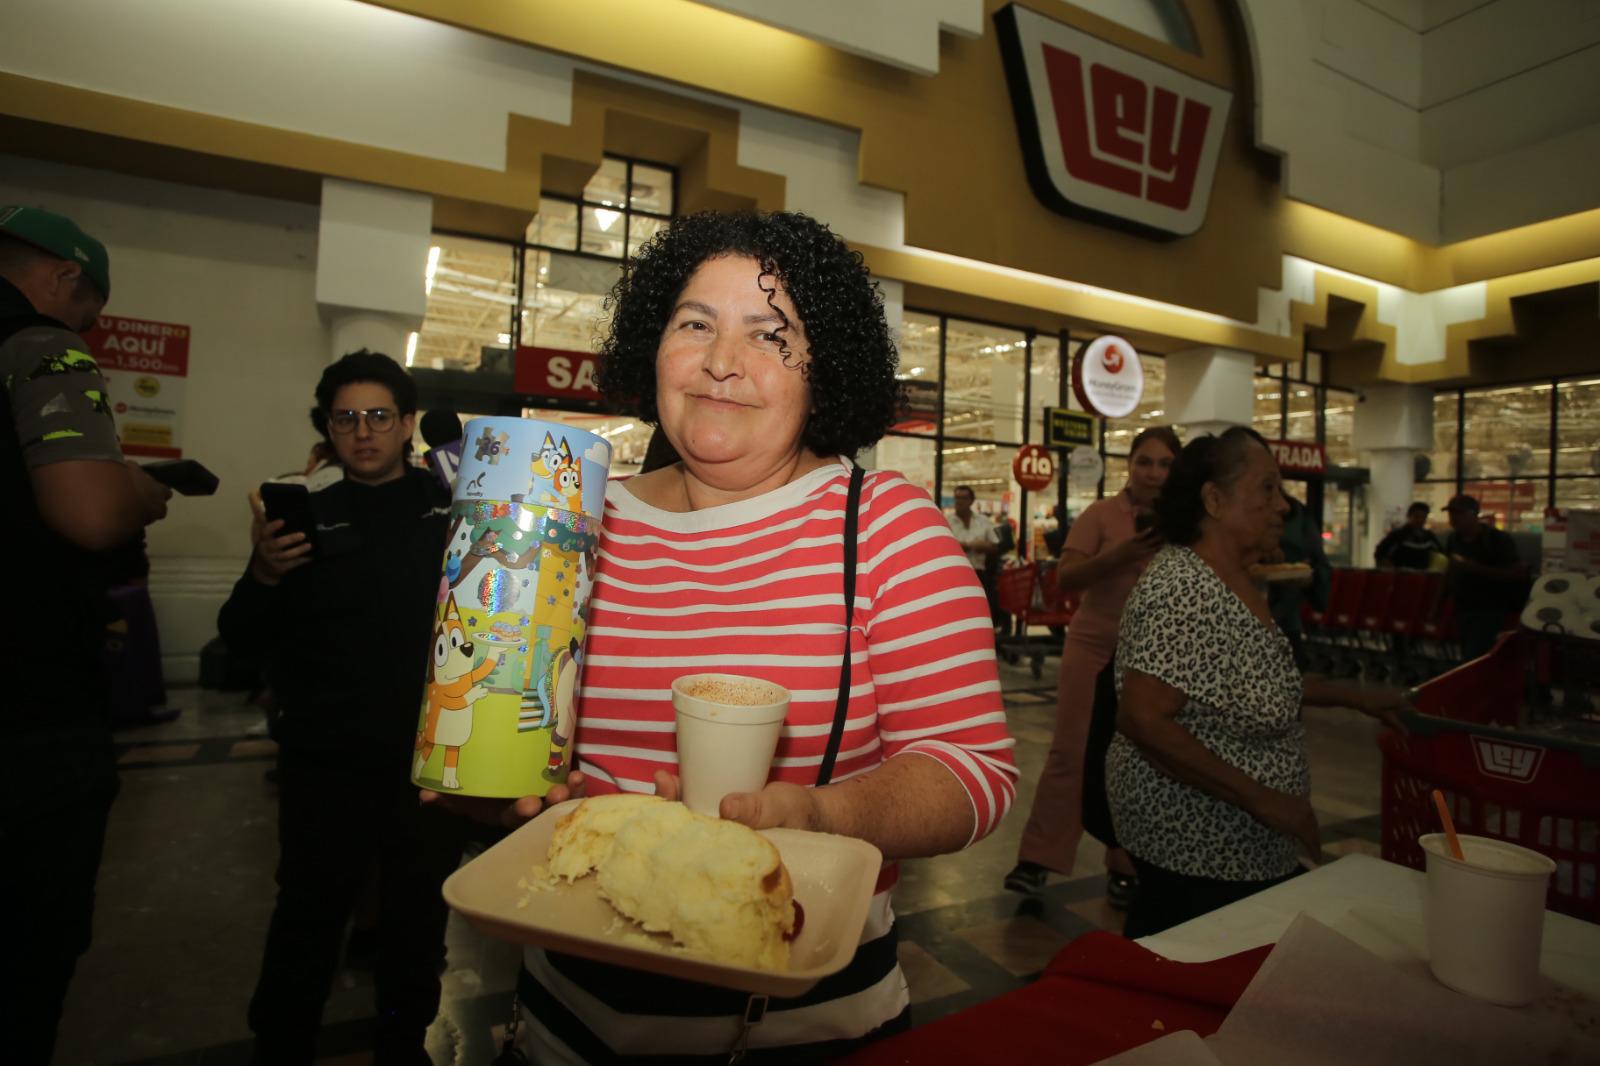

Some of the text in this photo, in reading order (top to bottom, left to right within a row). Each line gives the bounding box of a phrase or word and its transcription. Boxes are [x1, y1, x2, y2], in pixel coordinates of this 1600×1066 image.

[98, 317, 113, 329] U
[103, 333, 168, 356] AQUÍ
[546, 356, 601, 392] SA
[1021, 448, 1052, 475] ria
[1268, 444, 1323, 469] TRADA
